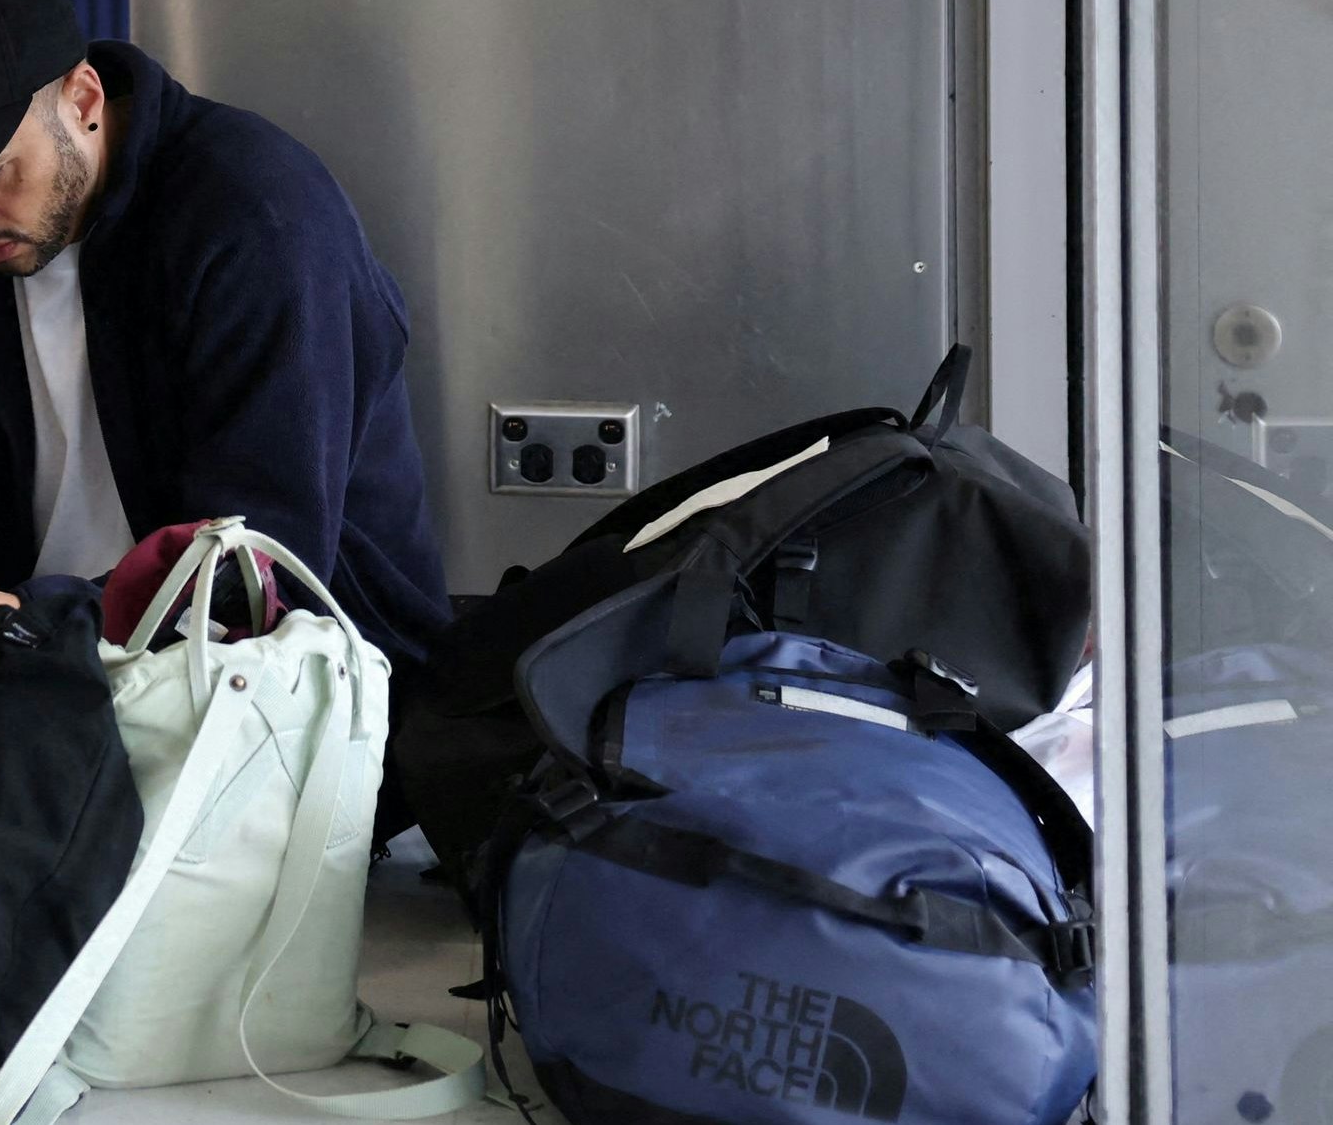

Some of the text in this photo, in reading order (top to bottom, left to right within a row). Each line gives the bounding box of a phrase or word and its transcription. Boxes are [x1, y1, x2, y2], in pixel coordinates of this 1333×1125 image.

[649, 989, 823, 1069] NORTH
[738, 971, 832, 1028] THE
[691, 1043, 816, 1105] FACE
